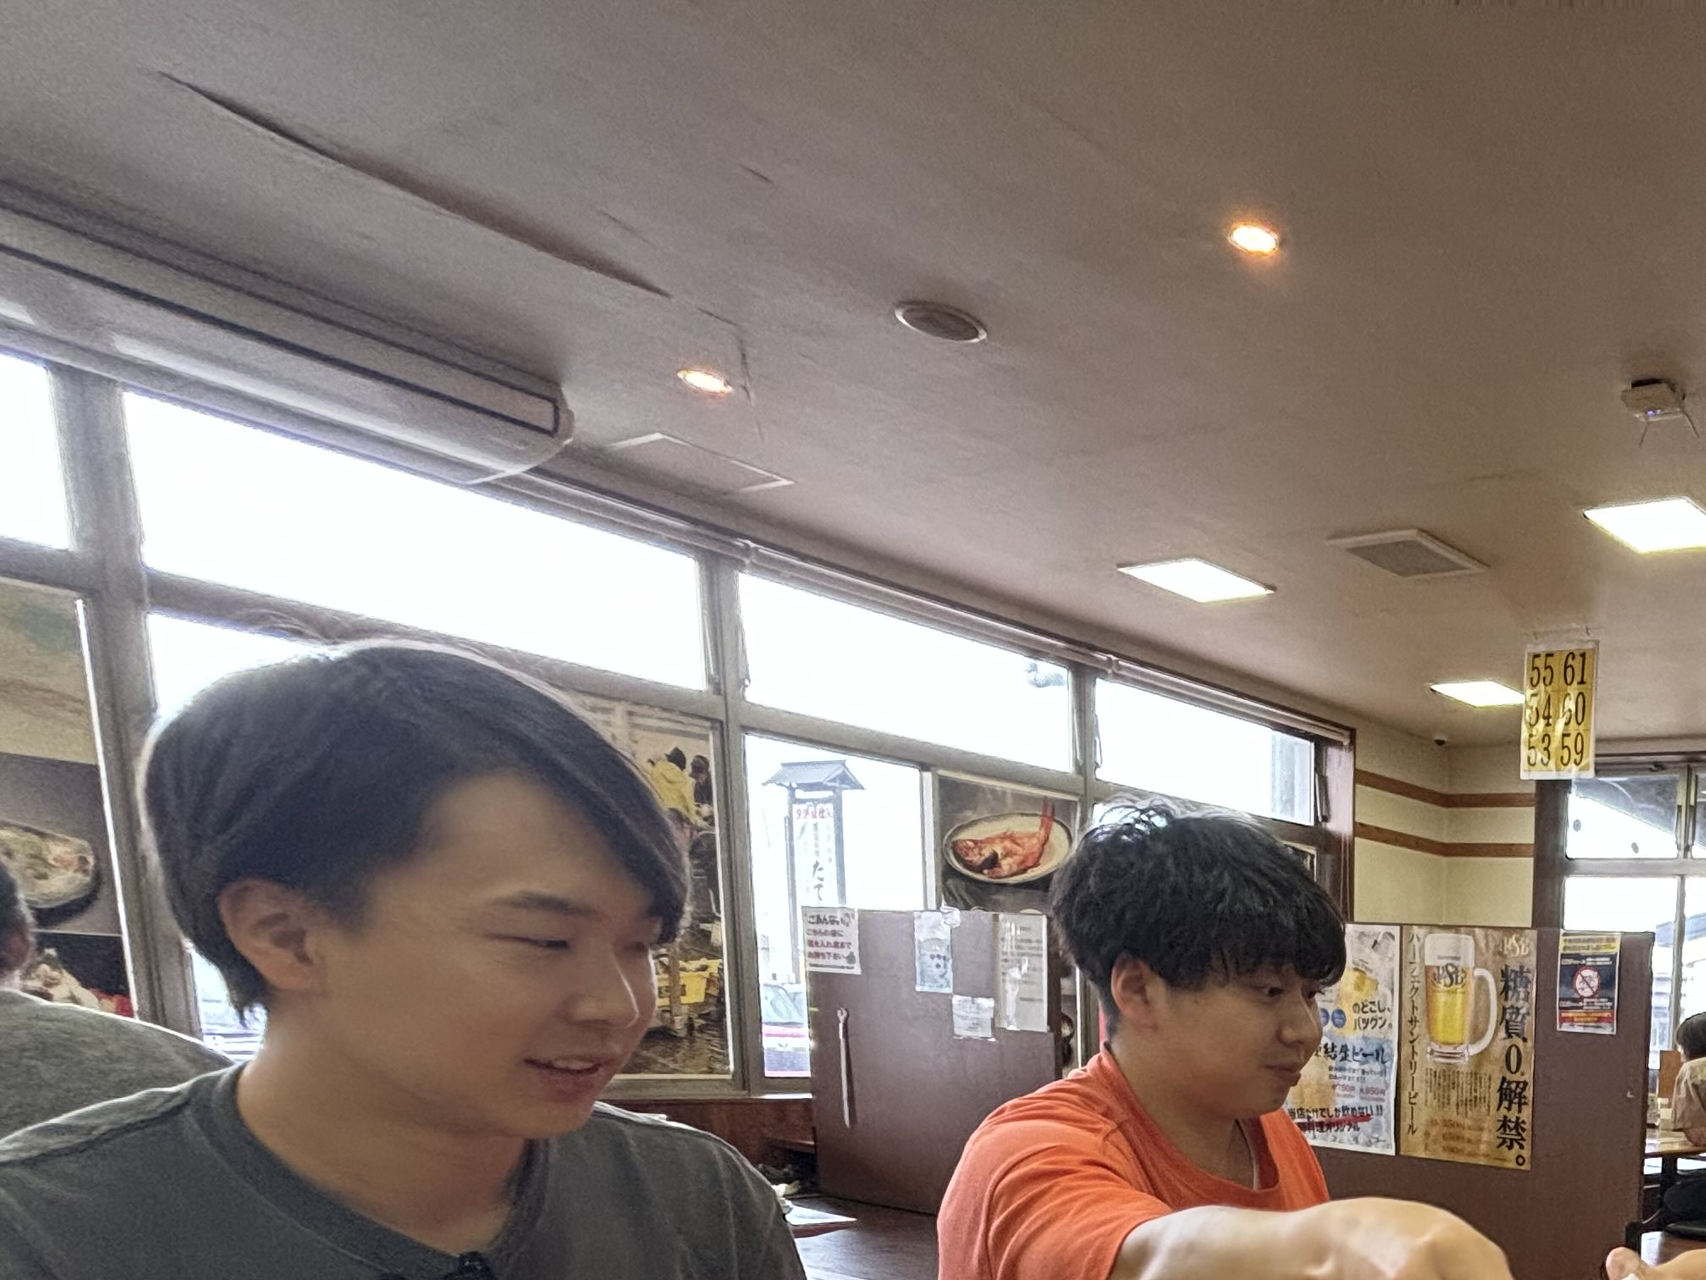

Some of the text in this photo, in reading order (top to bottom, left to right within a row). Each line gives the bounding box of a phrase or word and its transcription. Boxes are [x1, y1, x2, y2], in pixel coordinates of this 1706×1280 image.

[1530, 652, 1587, 688] 55 61
[1527, 692, 1586, 727] 54 60
[1527, 732, 1584, 767] 53 59
